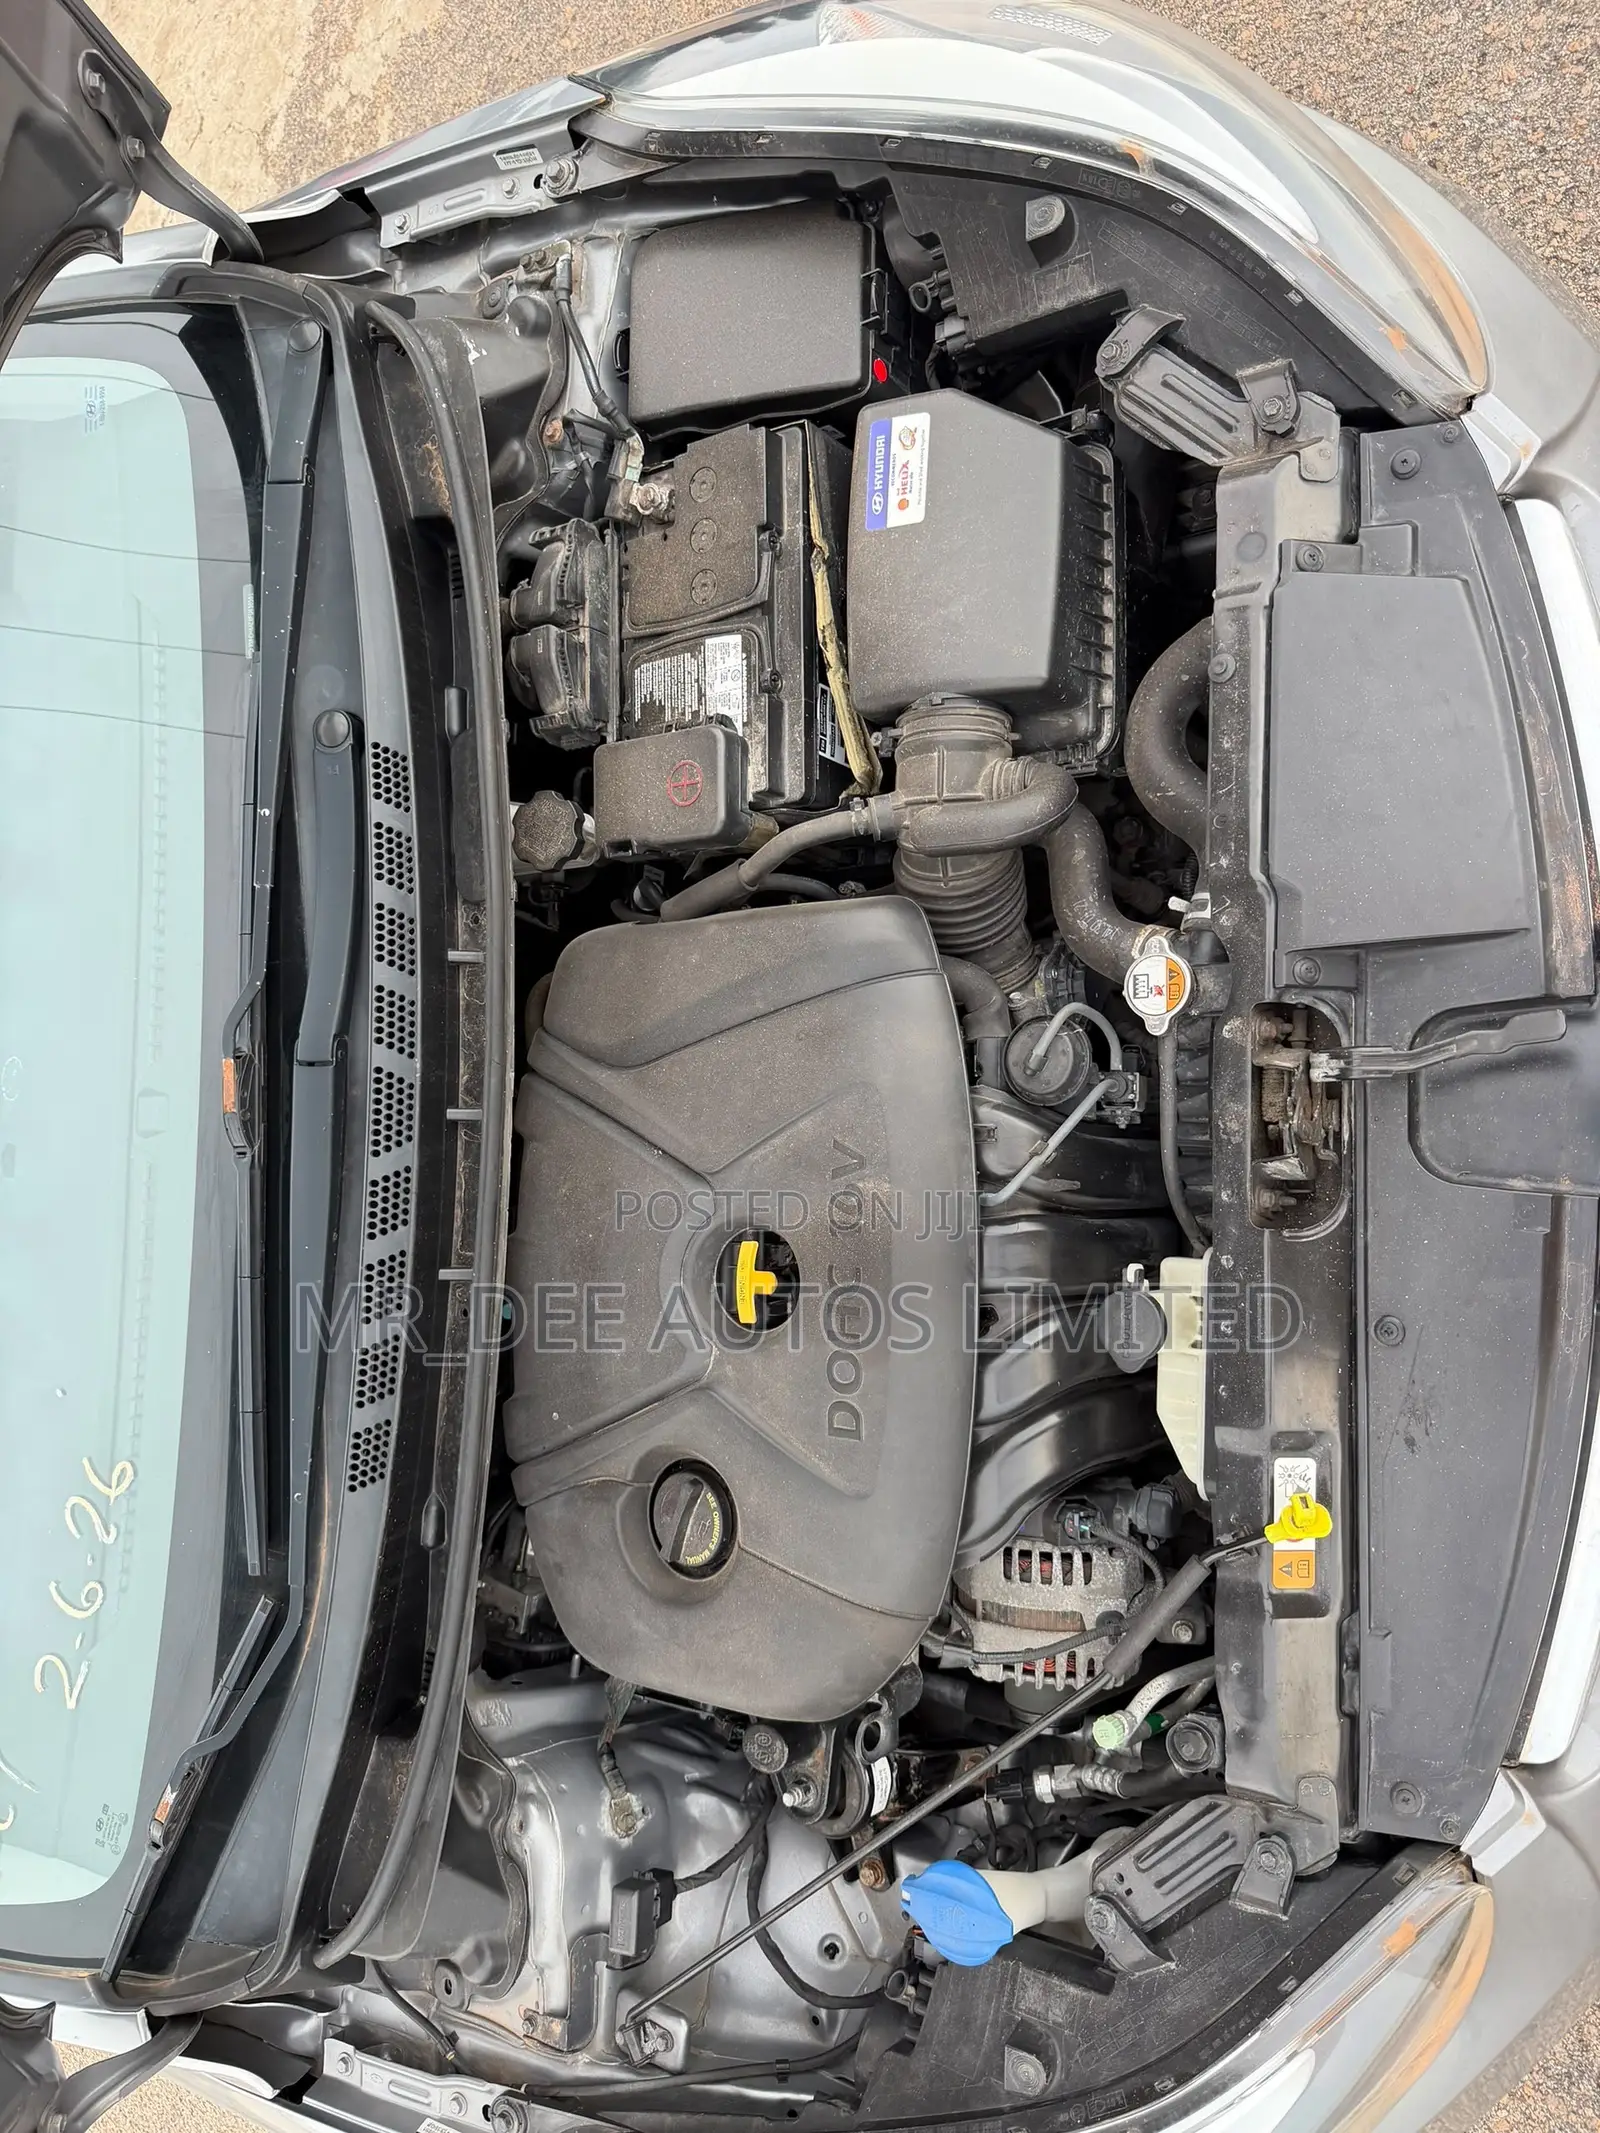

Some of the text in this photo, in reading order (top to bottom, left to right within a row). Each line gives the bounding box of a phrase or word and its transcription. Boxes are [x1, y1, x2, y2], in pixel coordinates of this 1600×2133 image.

[874, 435, 886, 490] HYUNDAI
[899, 461, 910, 495] HELIX
[1120, 1291, 1132, 1358] COOLANT
[705, 1492, 718, 1510] SEE
[686, 1549, 711, 1564] MANUAL
